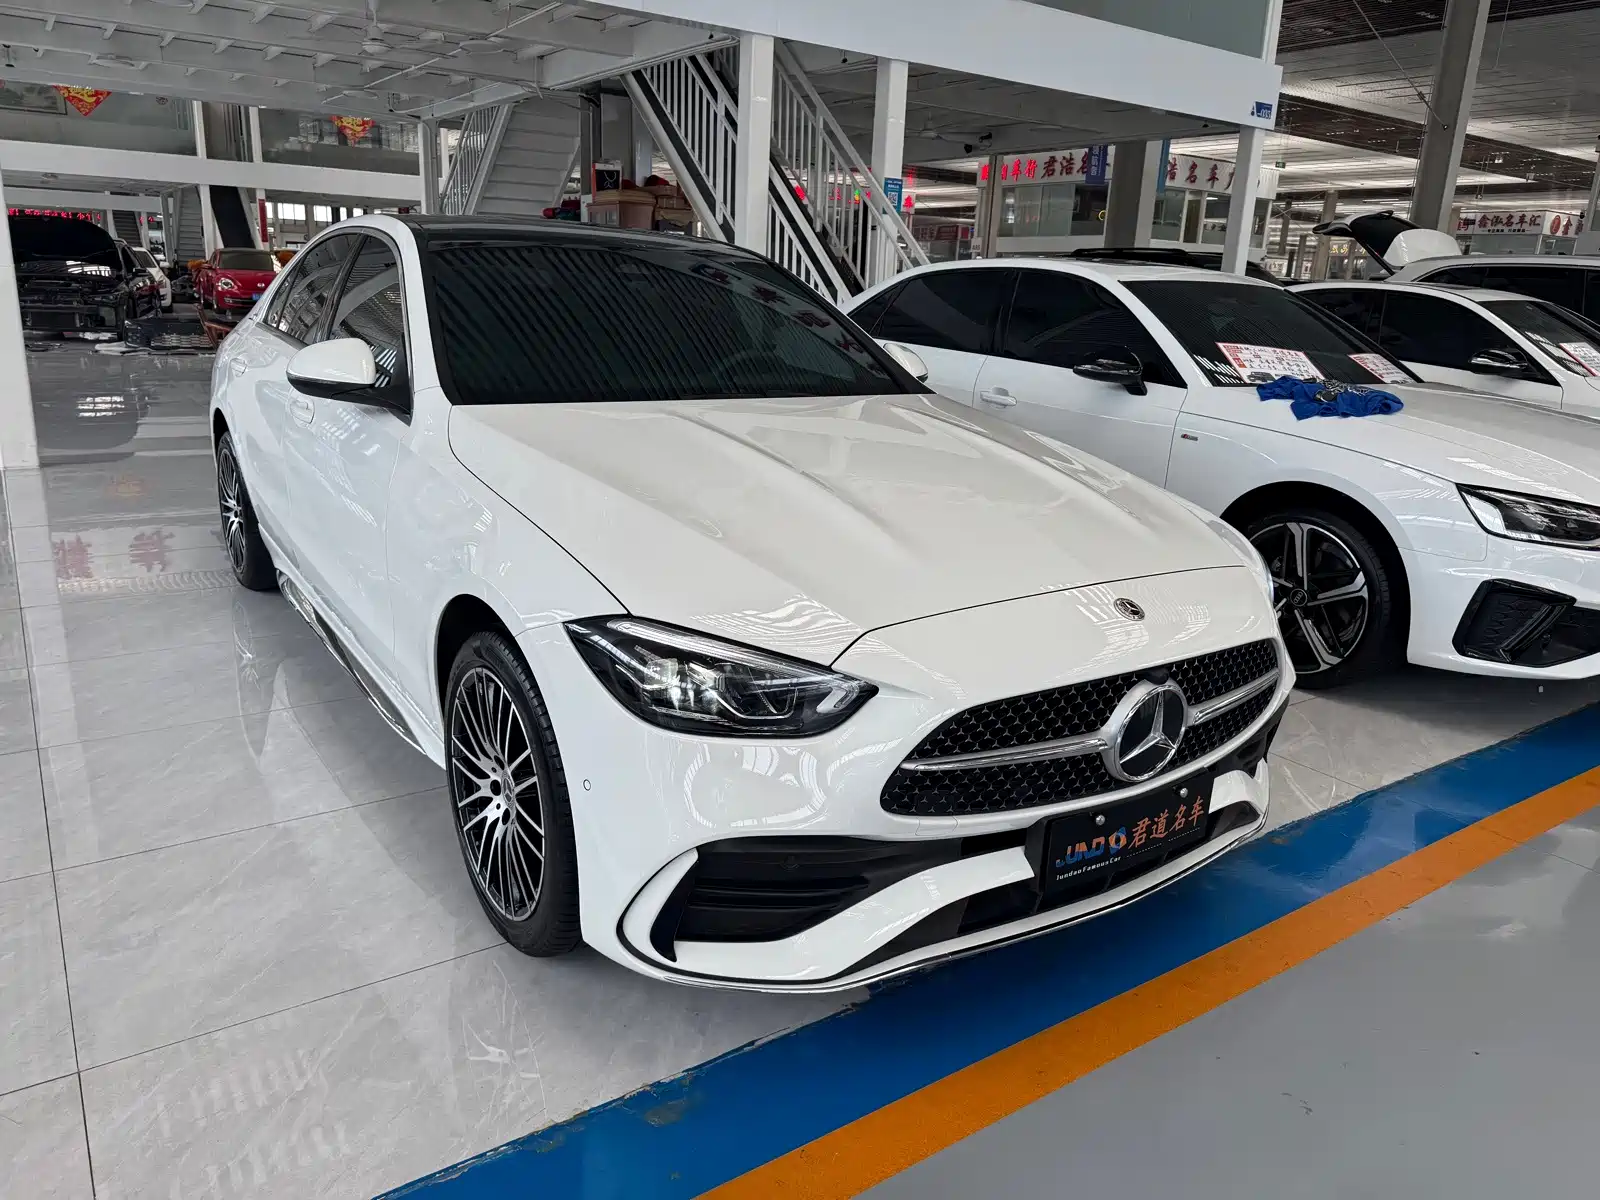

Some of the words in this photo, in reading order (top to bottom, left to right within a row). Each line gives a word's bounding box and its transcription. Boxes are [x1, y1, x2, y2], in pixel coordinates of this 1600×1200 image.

[1128, 795, 1205, 850] 君道名车
[1056, 868, 1082, 880] Jundao
[1083, 860, 1109, 873] Famous
[1110, 856, 1122, 864] Car
